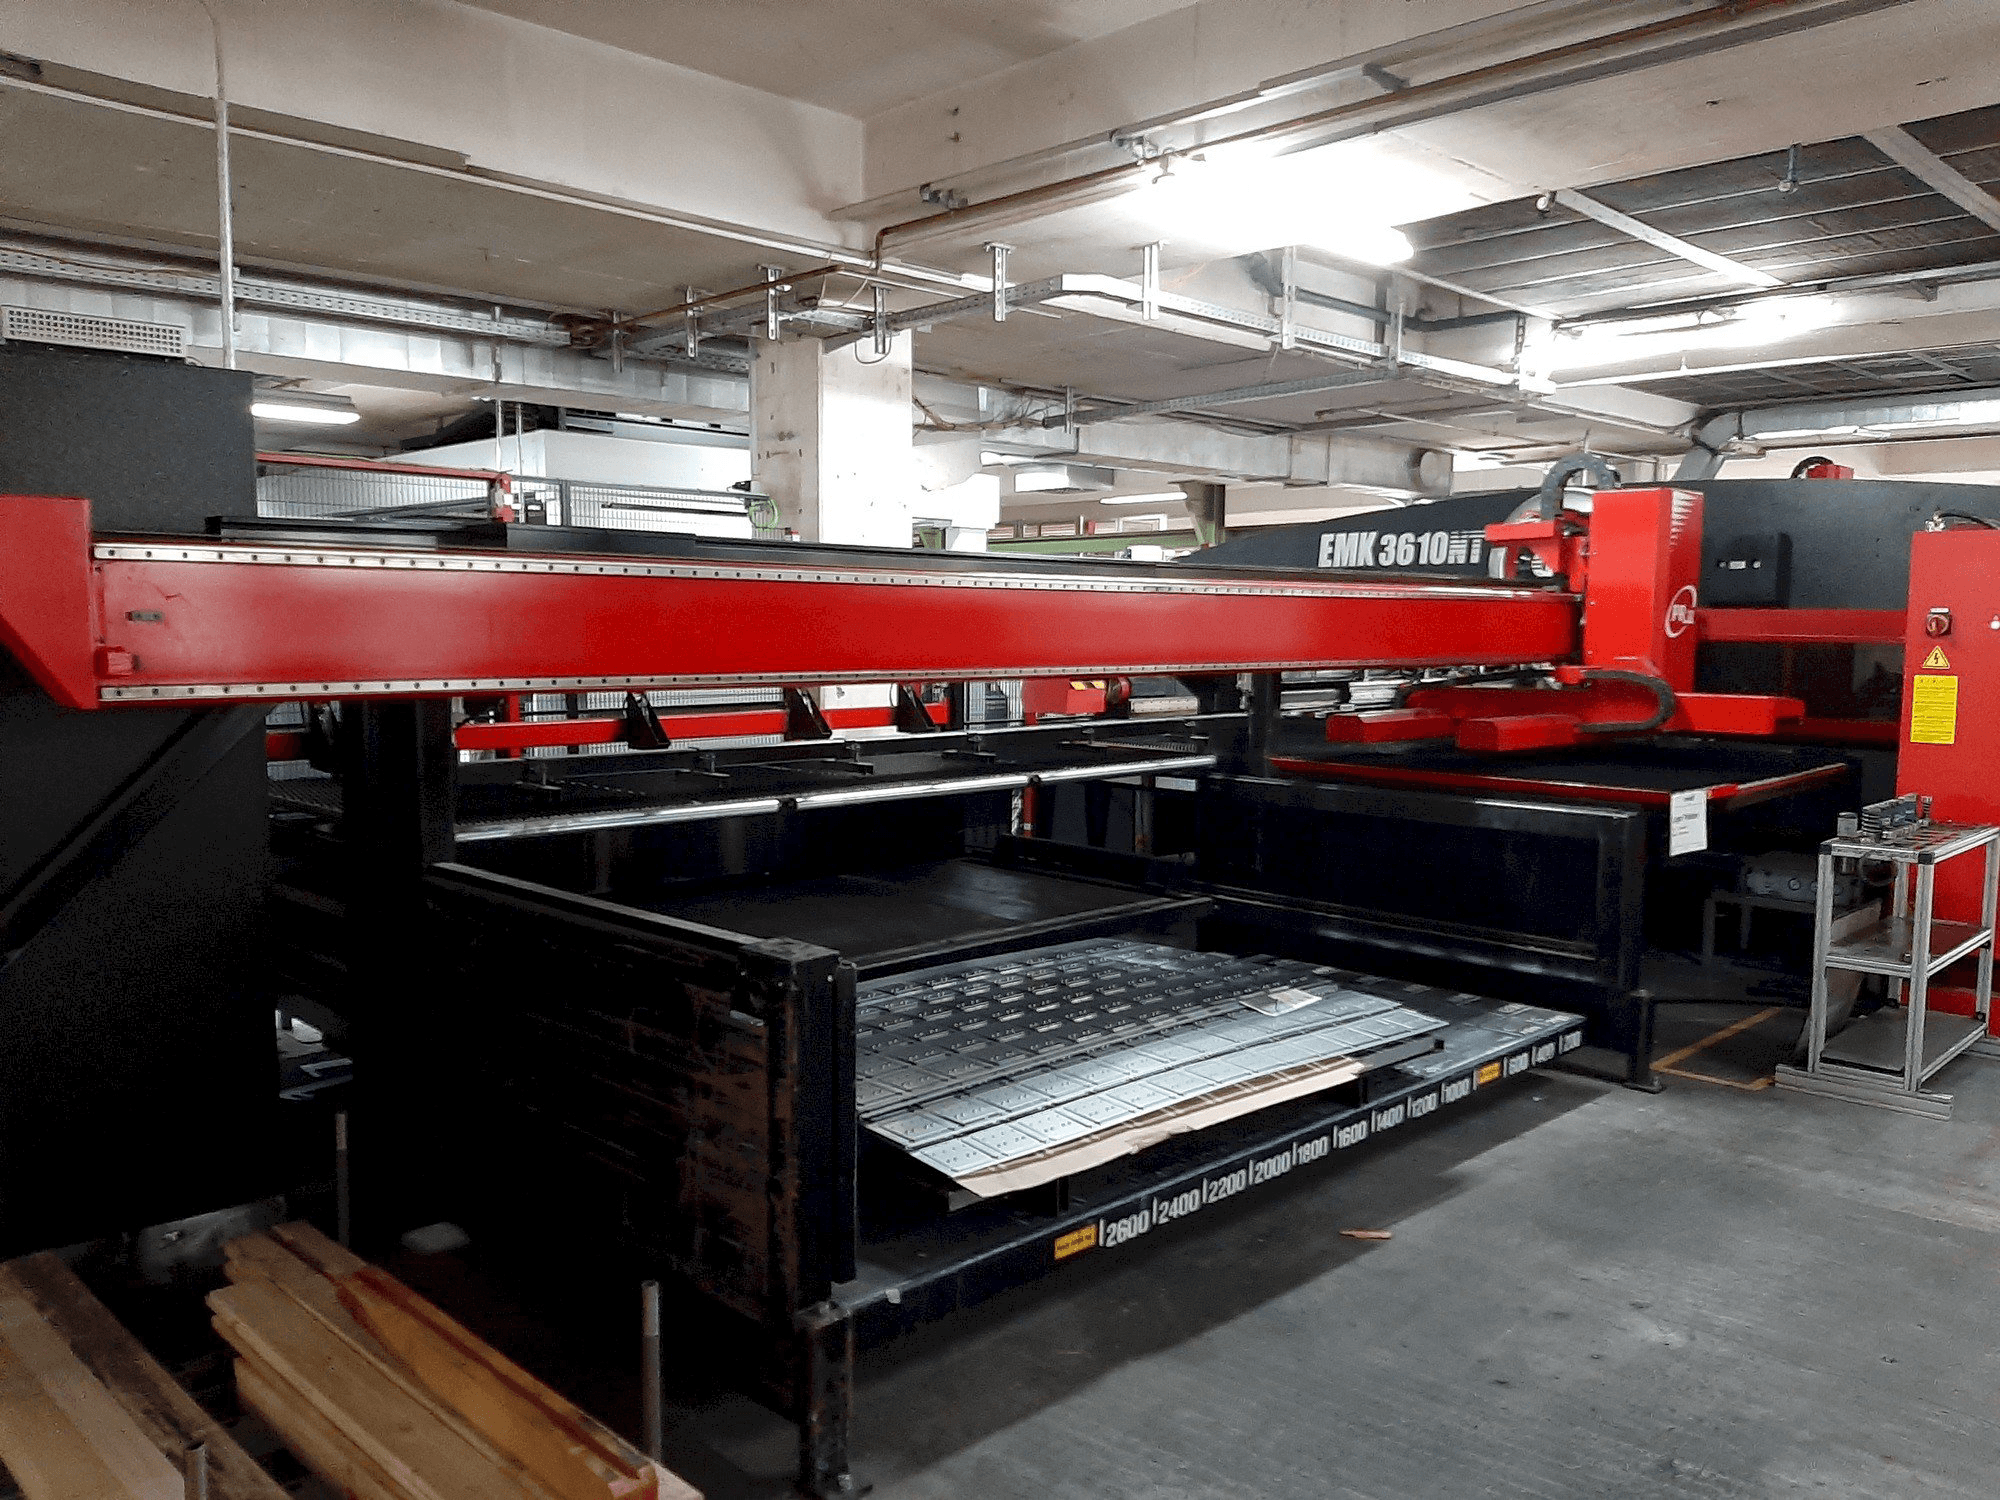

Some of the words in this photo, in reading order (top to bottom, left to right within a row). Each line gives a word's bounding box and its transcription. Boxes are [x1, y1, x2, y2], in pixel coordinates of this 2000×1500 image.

[1318, 531, 1378, 568] EMK
[1106, 1209, 1149, 1247] 2600
[1159, 1189, 1200, 1224] 2400
[1208, 1169, 1247, 1203] 2200
[1255, 1150, 1291, 1184] 2000
[1299, 1135, 1330, 1165] 1800
[1338, 1120, 1368, 1149] 1600
